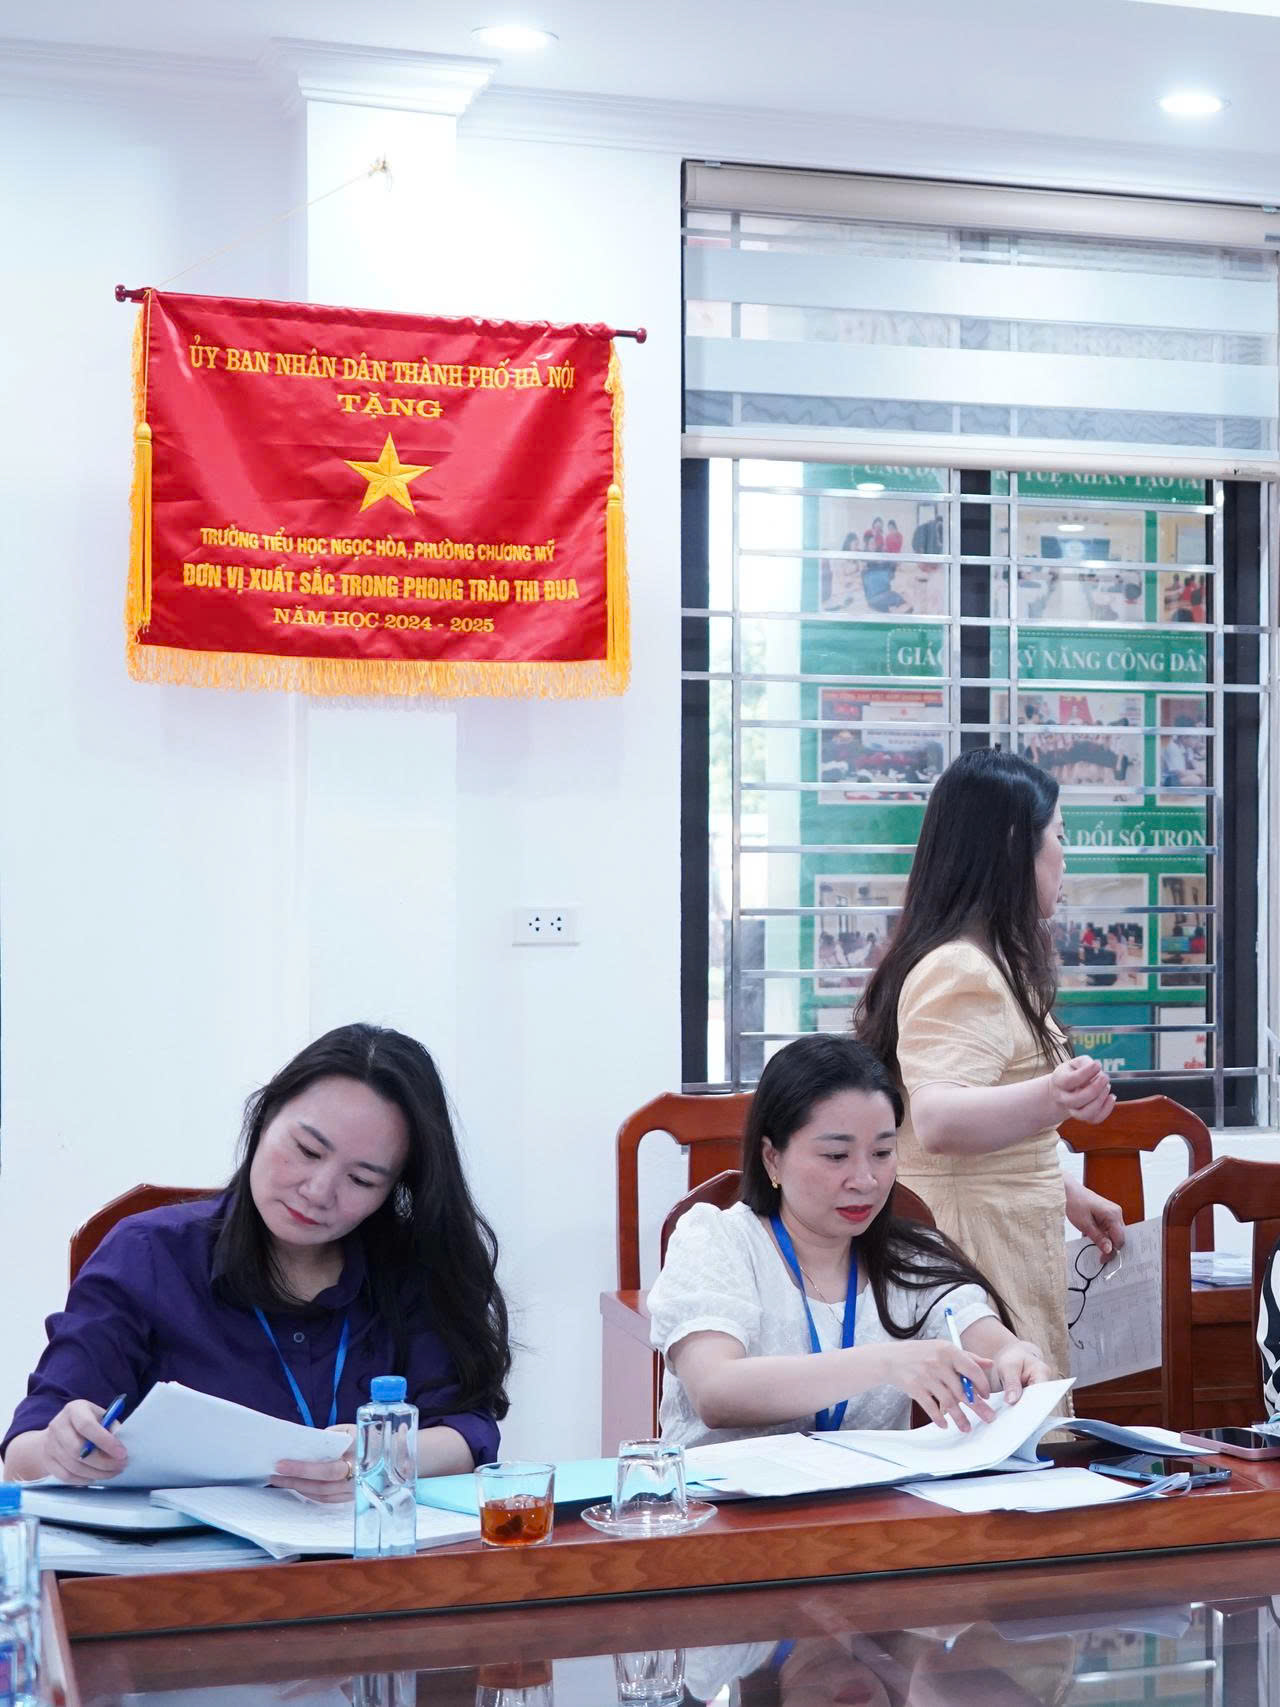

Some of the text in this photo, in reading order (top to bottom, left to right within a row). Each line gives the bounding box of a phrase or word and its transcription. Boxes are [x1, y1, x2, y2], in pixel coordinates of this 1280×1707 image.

[189, 334, 576, 394] ỦY BAN NHÂN DÂN THÀNH PHỐ HÀ NỘI
[336, 391, 443, 419] TẶNG
[200, 524, 259, 550] TRƯỜNG
[261, 526, 294, 553] TIỂU
[297, 537, 328, 560] HỌC
[331, 538, 373, 561] NGỌC
[414, 538, 475, 561] PHƯỜNG
[534, 538, 556, 563] MỸ
[183, 562, 579, 602] ĐƠN VỊ XUẤT SẮC TRONG PHONG TRÀO THI ĐUA
[272, 605, 326, 625] NĂM
[332, 611, 379, 631] HỌC
[384, 614, 433, 631] 2024
[450, 617, 495, 633] 2025
[1043, 646, 1100, 670] NĂNG
[1106, 647, 1165, 672] CÔNG
[1119, 820, 1146, 846] SỐ
